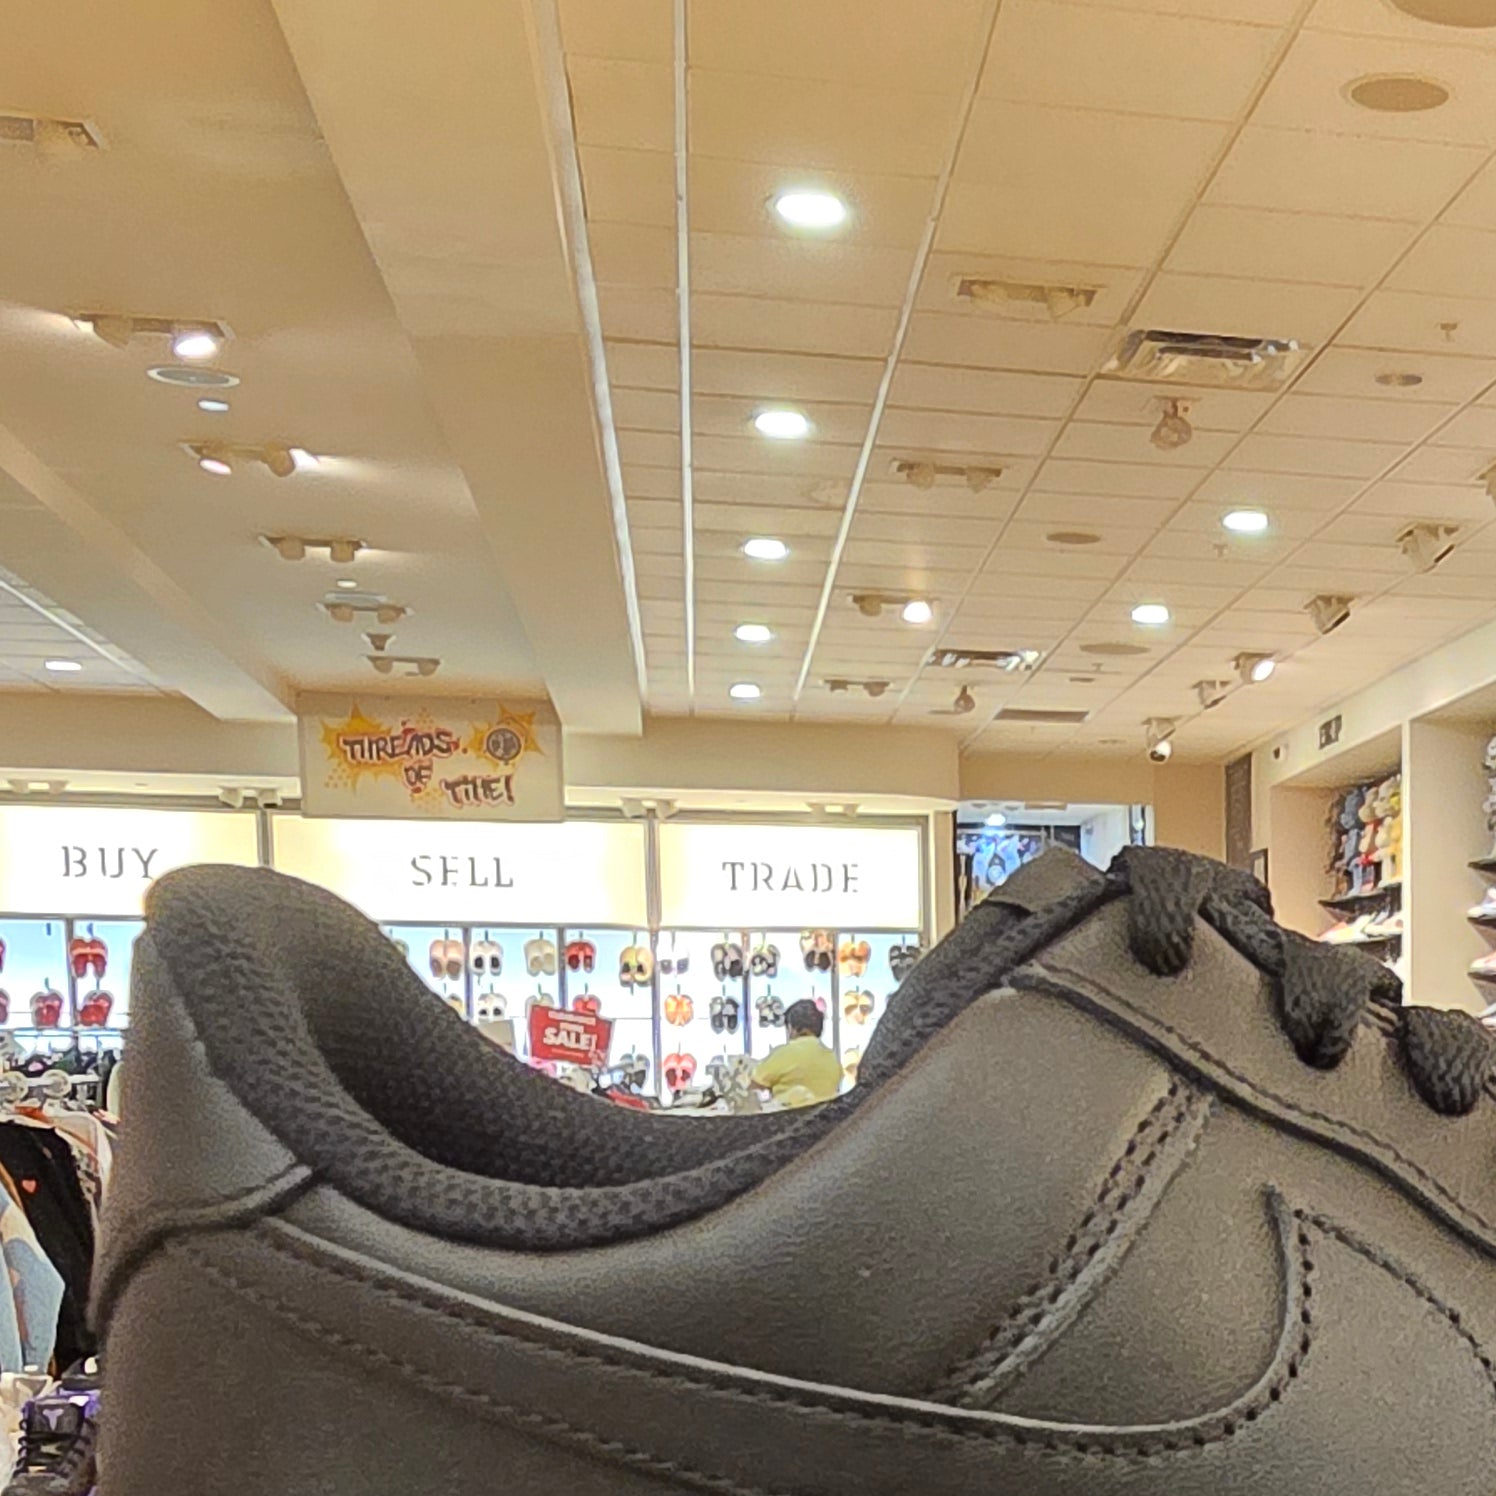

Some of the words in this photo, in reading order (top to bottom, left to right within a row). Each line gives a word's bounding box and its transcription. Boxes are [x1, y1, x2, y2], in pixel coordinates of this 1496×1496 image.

[61, 845, 159, 880] BUY
[410, 855, 514, 888] SELL
[721, 861, 859, 893] TRADE
[542, 1026, 598, 1056] SALE!
